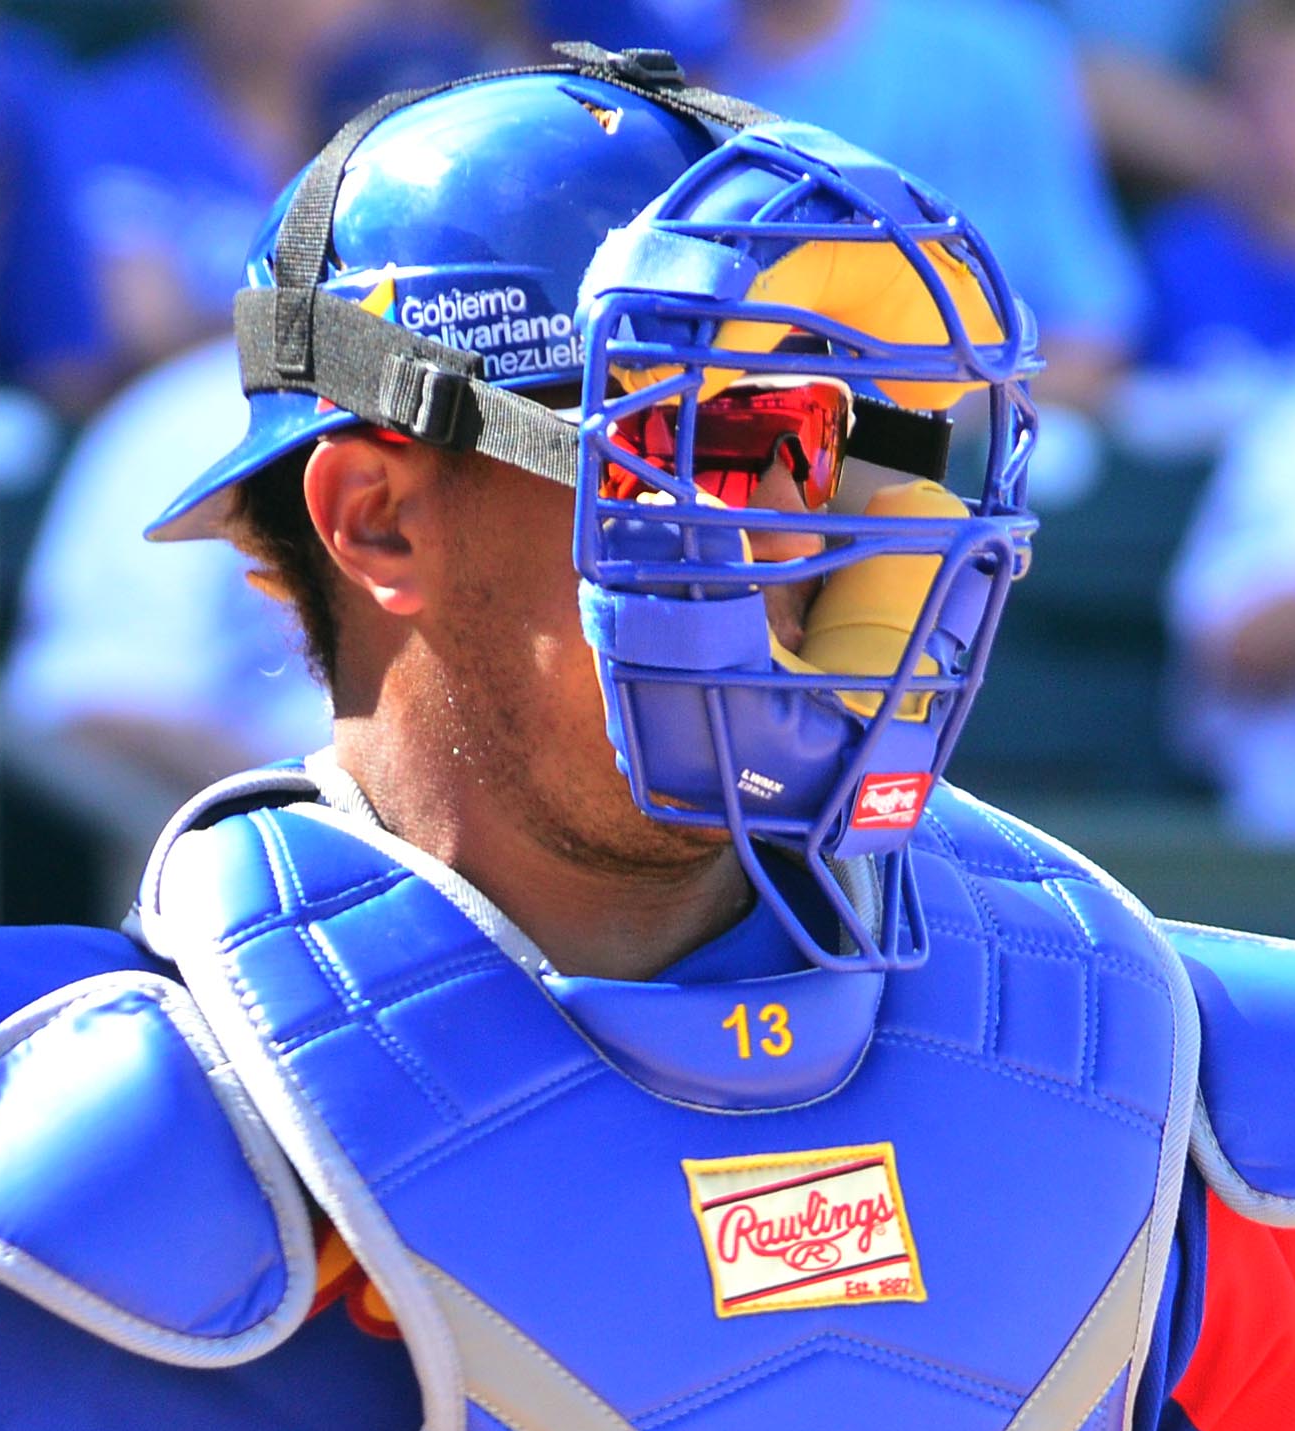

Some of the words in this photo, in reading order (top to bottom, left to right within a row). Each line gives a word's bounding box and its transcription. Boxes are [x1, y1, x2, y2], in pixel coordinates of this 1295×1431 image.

[402, 288, 526, 329] Gobierno
[413, 314, 572, 350] livariano
[721, 1003, 794, 1059] 13
[719, 1190, 895, 1263] Rawlings
